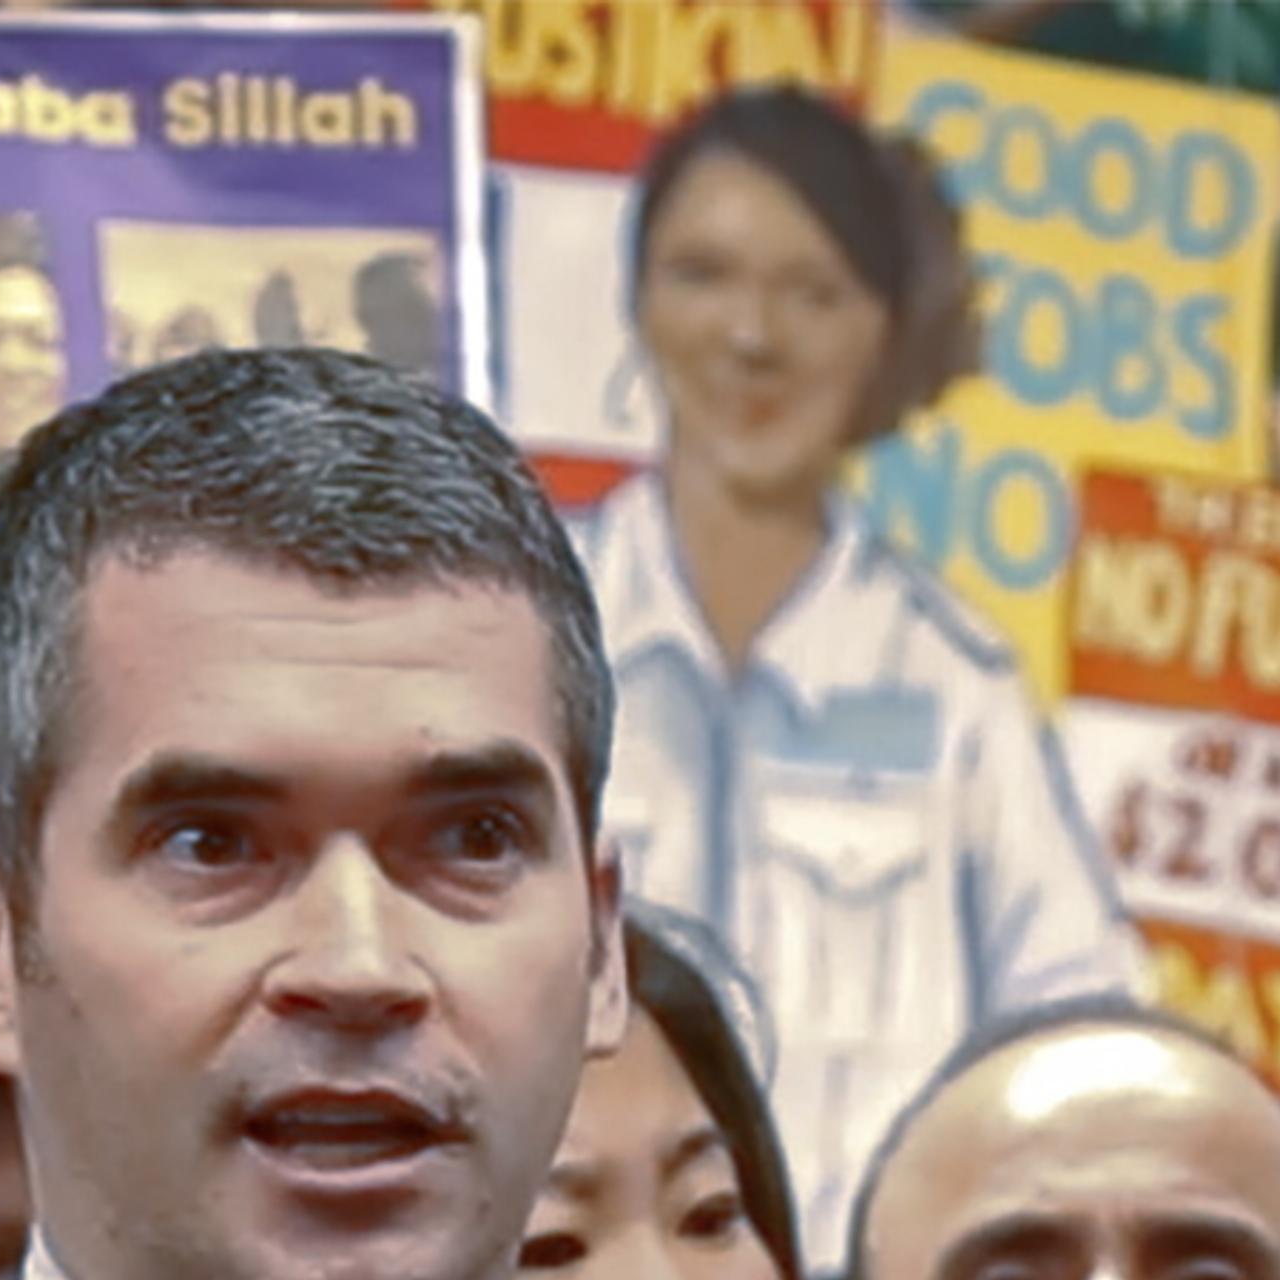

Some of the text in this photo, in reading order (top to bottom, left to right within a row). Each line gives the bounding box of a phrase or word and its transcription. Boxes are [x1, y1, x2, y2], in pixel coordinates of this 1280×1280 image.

[164, 72, 418, 148] Sillah
[970, 250, 1240, 442] OBS
[860, 422, 1075, 592] NO
[1075, 535, 1192, 666] NO
